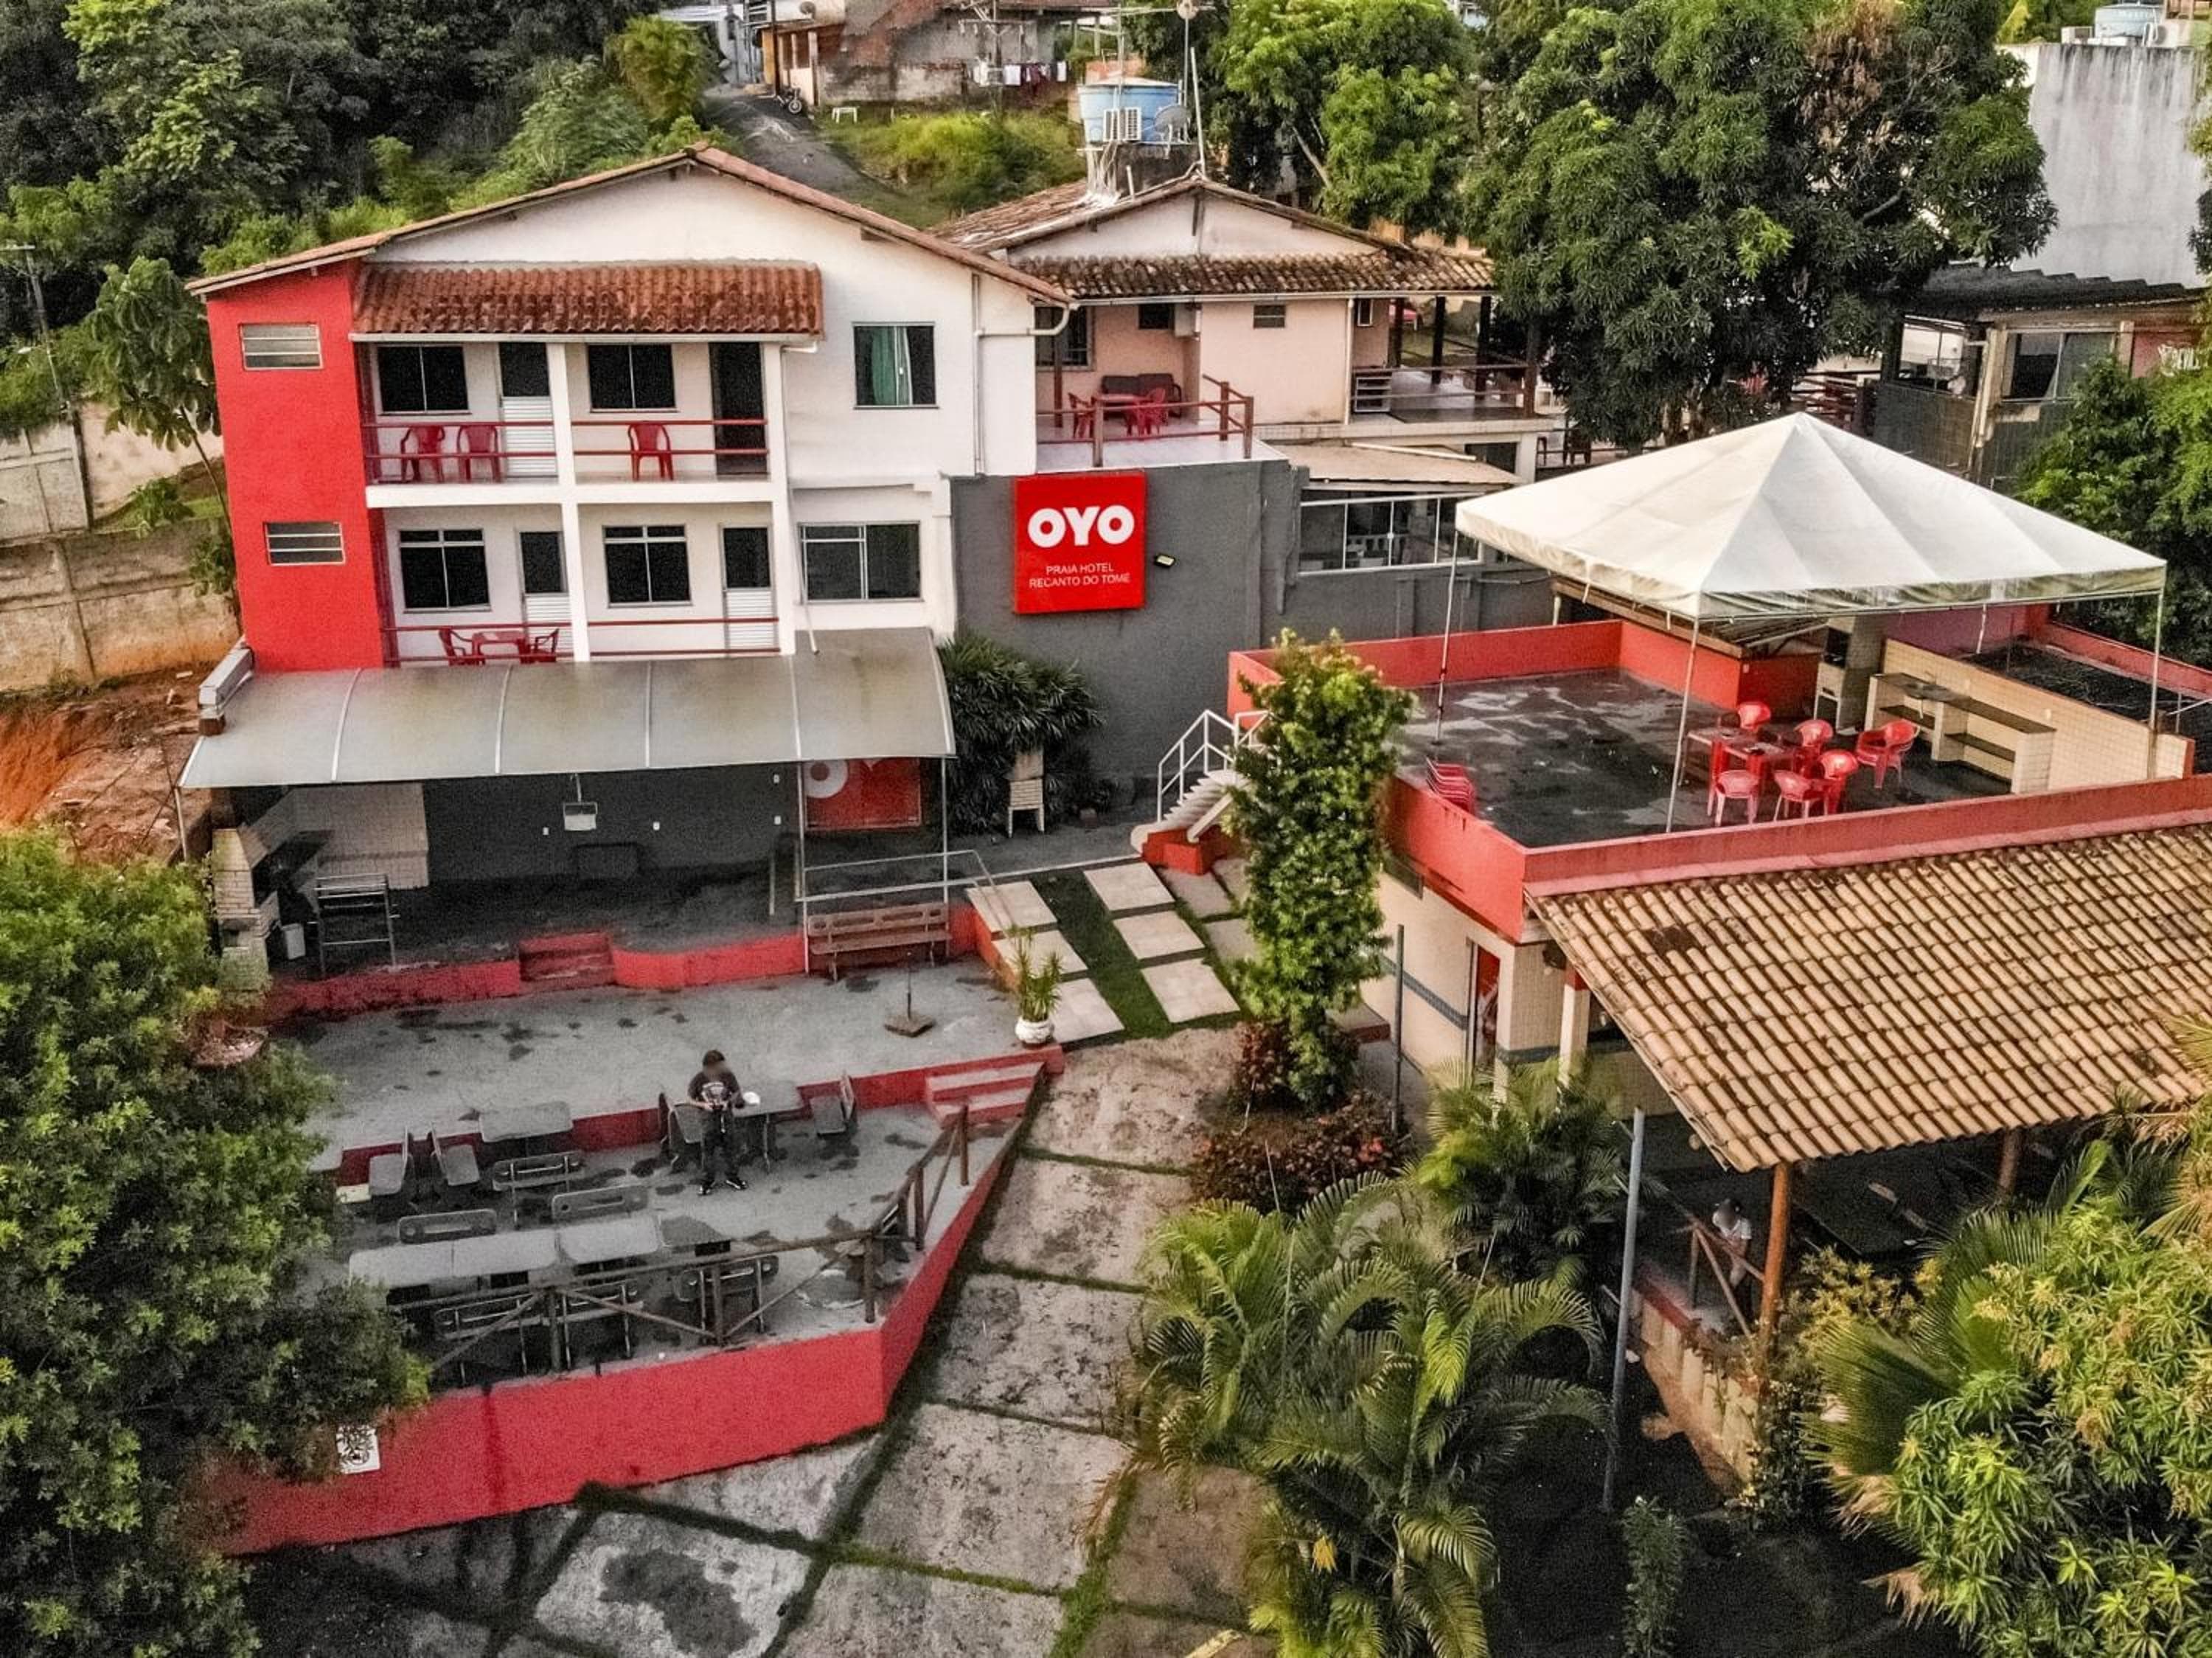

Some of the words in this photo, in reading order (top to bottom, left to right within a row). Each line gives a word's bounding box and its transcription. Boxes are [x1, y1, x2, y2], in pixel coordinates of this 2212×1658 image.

[1028, 505, 1135, 548] OYO
[1046, 564, 1078, 575] PRAIA
[1079, 562, 1114, 574] HOTEL
[1029, 576, 1080, 589] RECANTO
[1082, 575, 1099, 586] DO
